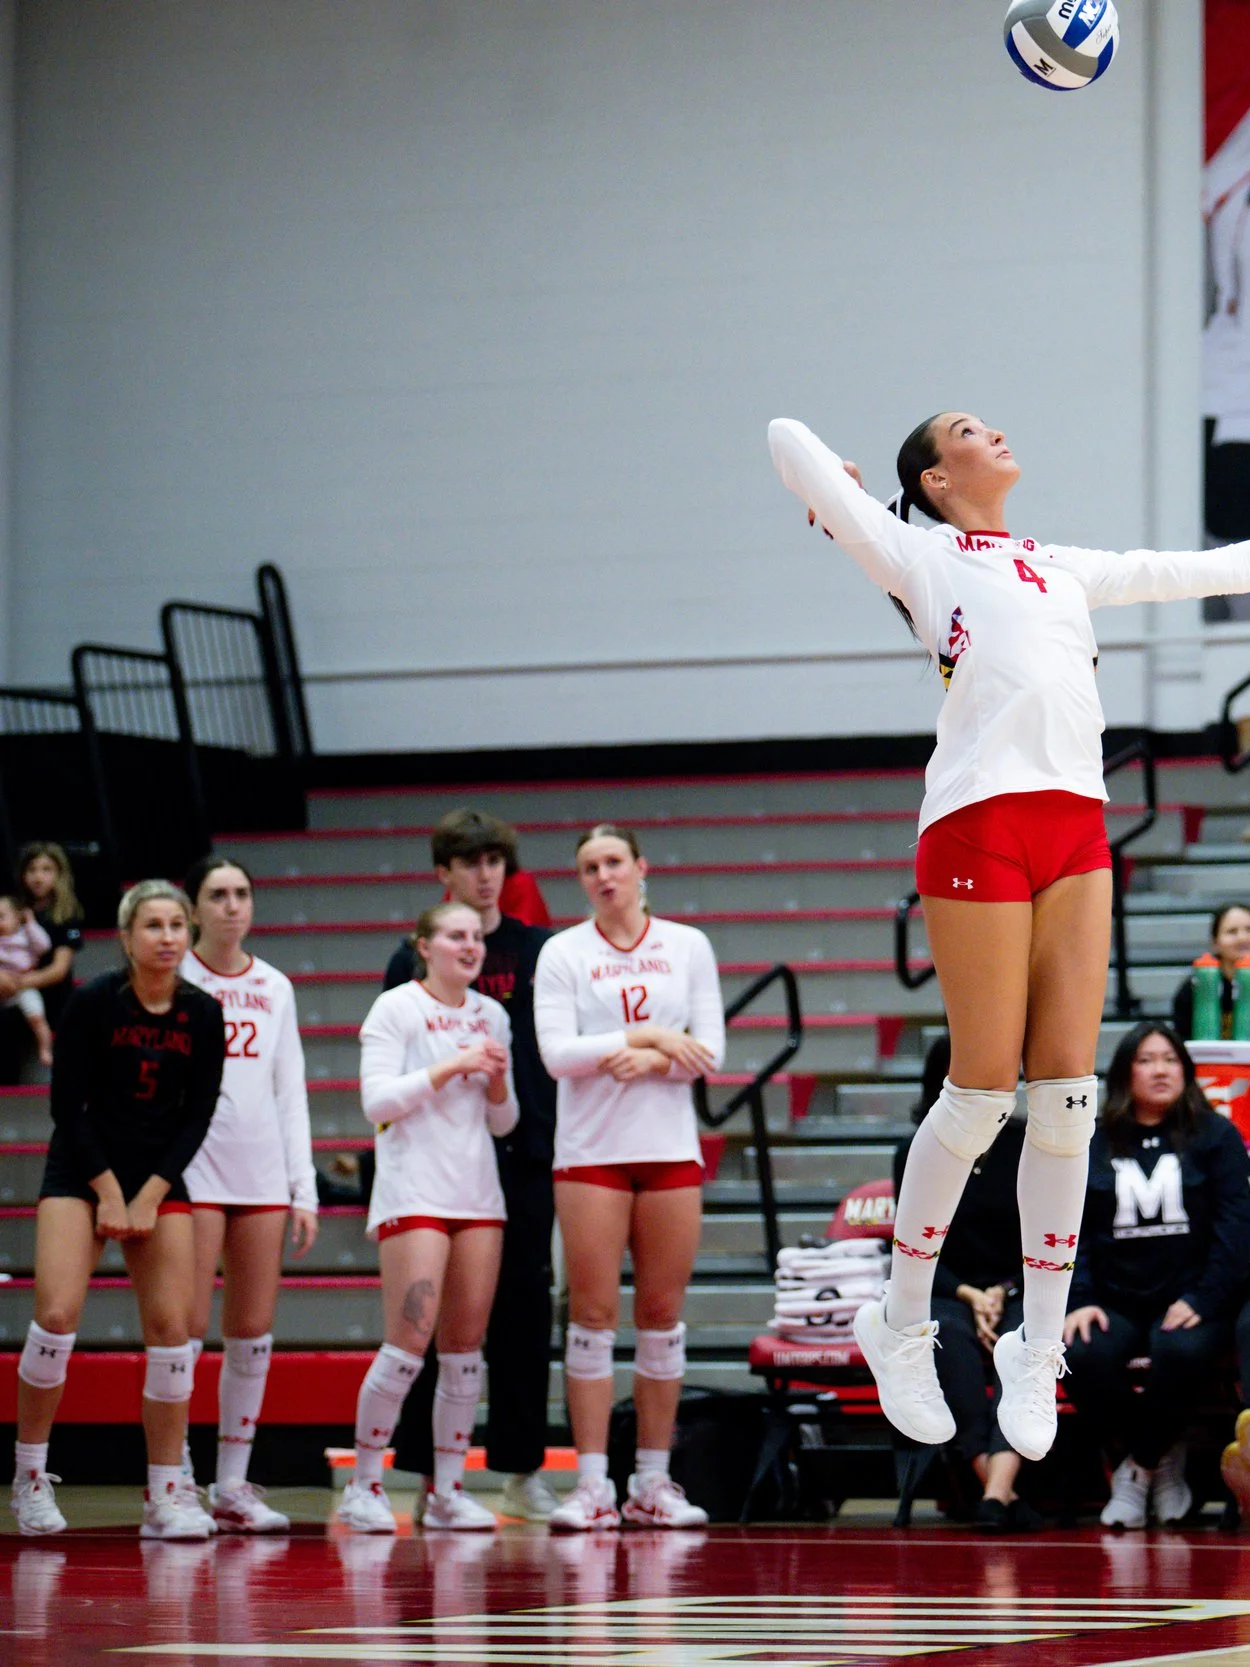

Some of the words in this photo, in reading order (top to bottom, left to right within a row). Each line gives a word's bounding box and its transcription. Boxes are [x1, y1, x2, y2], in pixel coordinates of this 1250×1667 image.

[1013, 558, 1048, 594] 4
[621, 983, 651, 1025] 12
[225, 1021, 260, 1059] 22
[133, 1059, 160, 1100] 5
[1110, 1152, 1191, 1228] M
